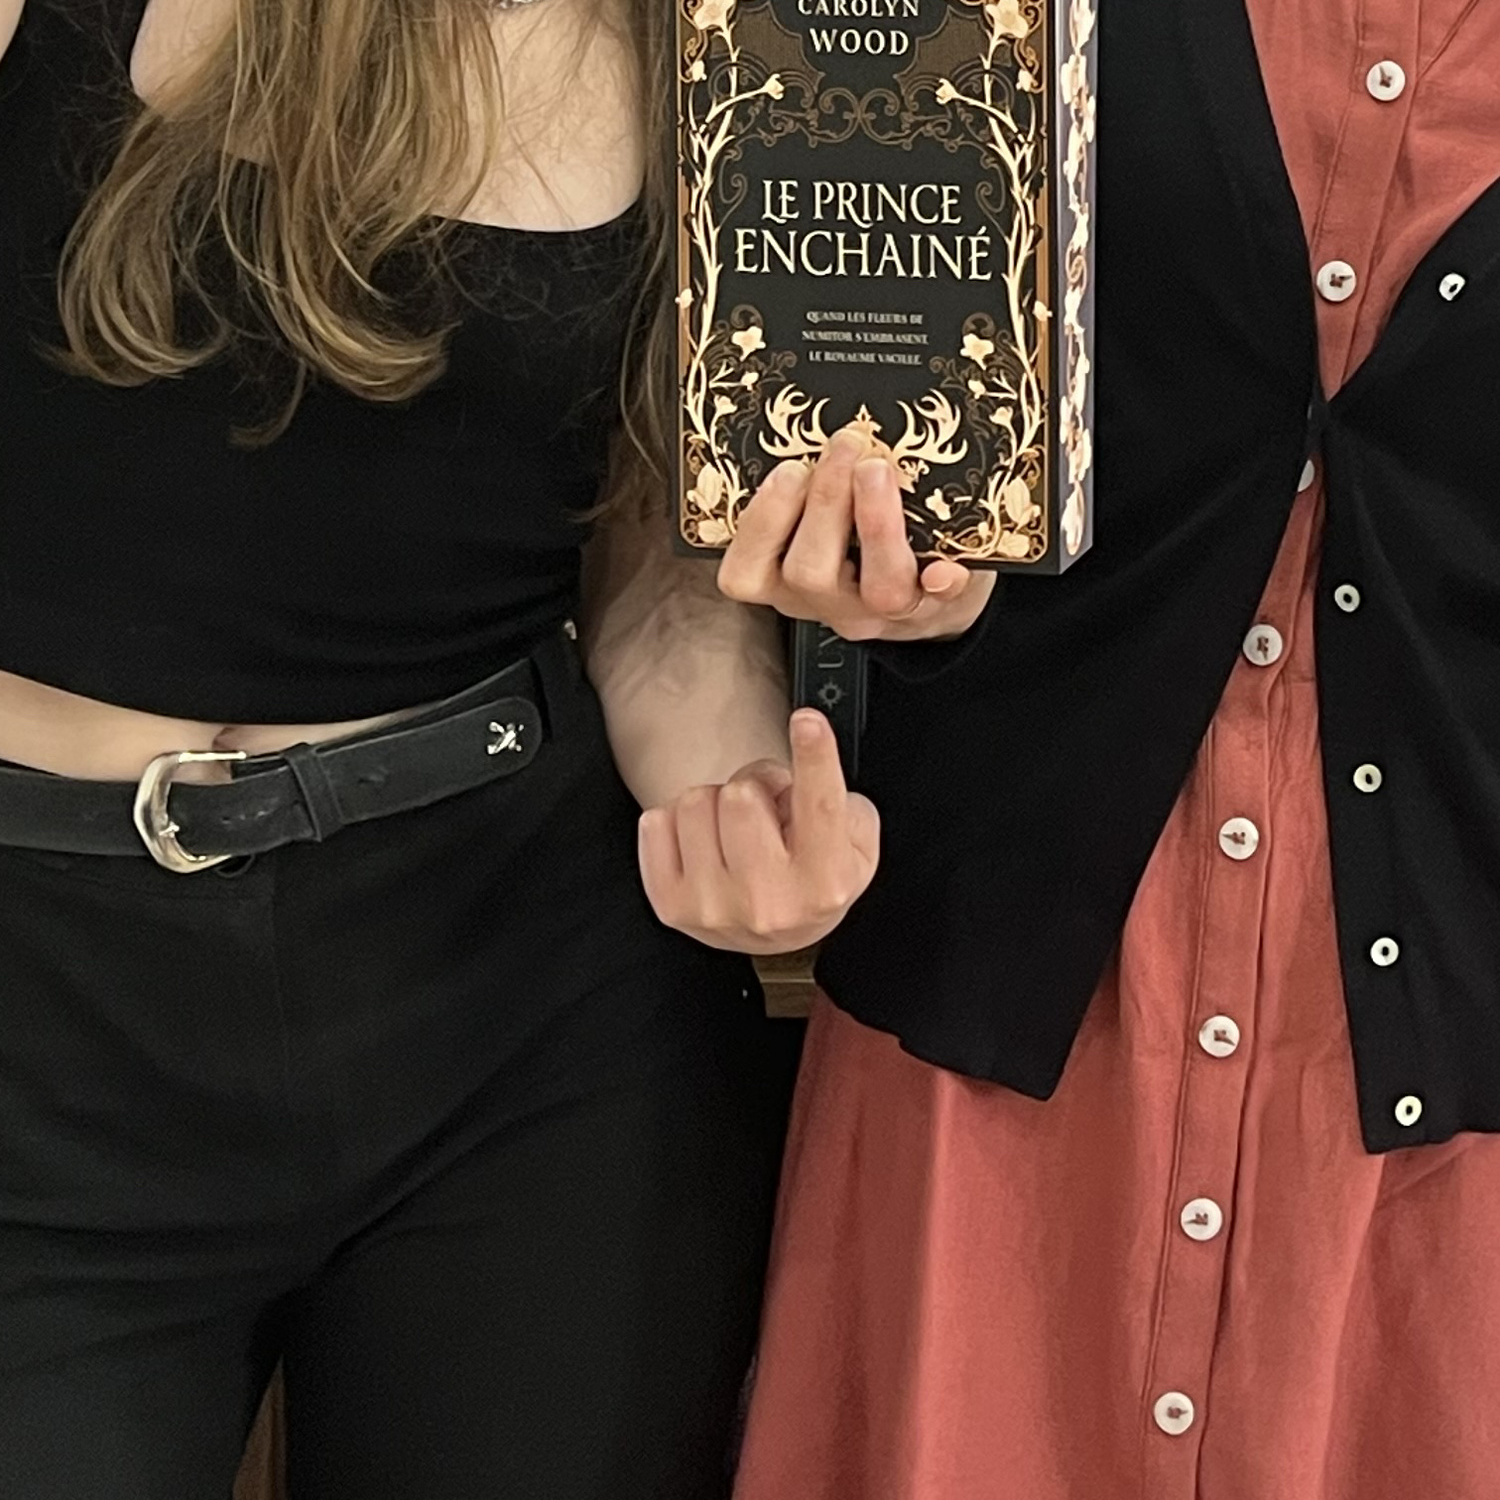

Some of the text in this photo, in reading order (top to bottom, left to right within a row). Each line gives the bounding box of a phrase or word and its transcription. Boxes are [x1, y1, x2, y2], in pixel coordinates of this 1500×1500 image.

[809, 28, 909, 55] WOOD
[761, 179, 962, 228] LE PRINCE
[734, 225, 993, 281] ENCHAINÉ
[806, 311, 923, 325] QUAND LES FLEURS DE
[809, 350, 922, 365] LE ROYAUME VACILLE
